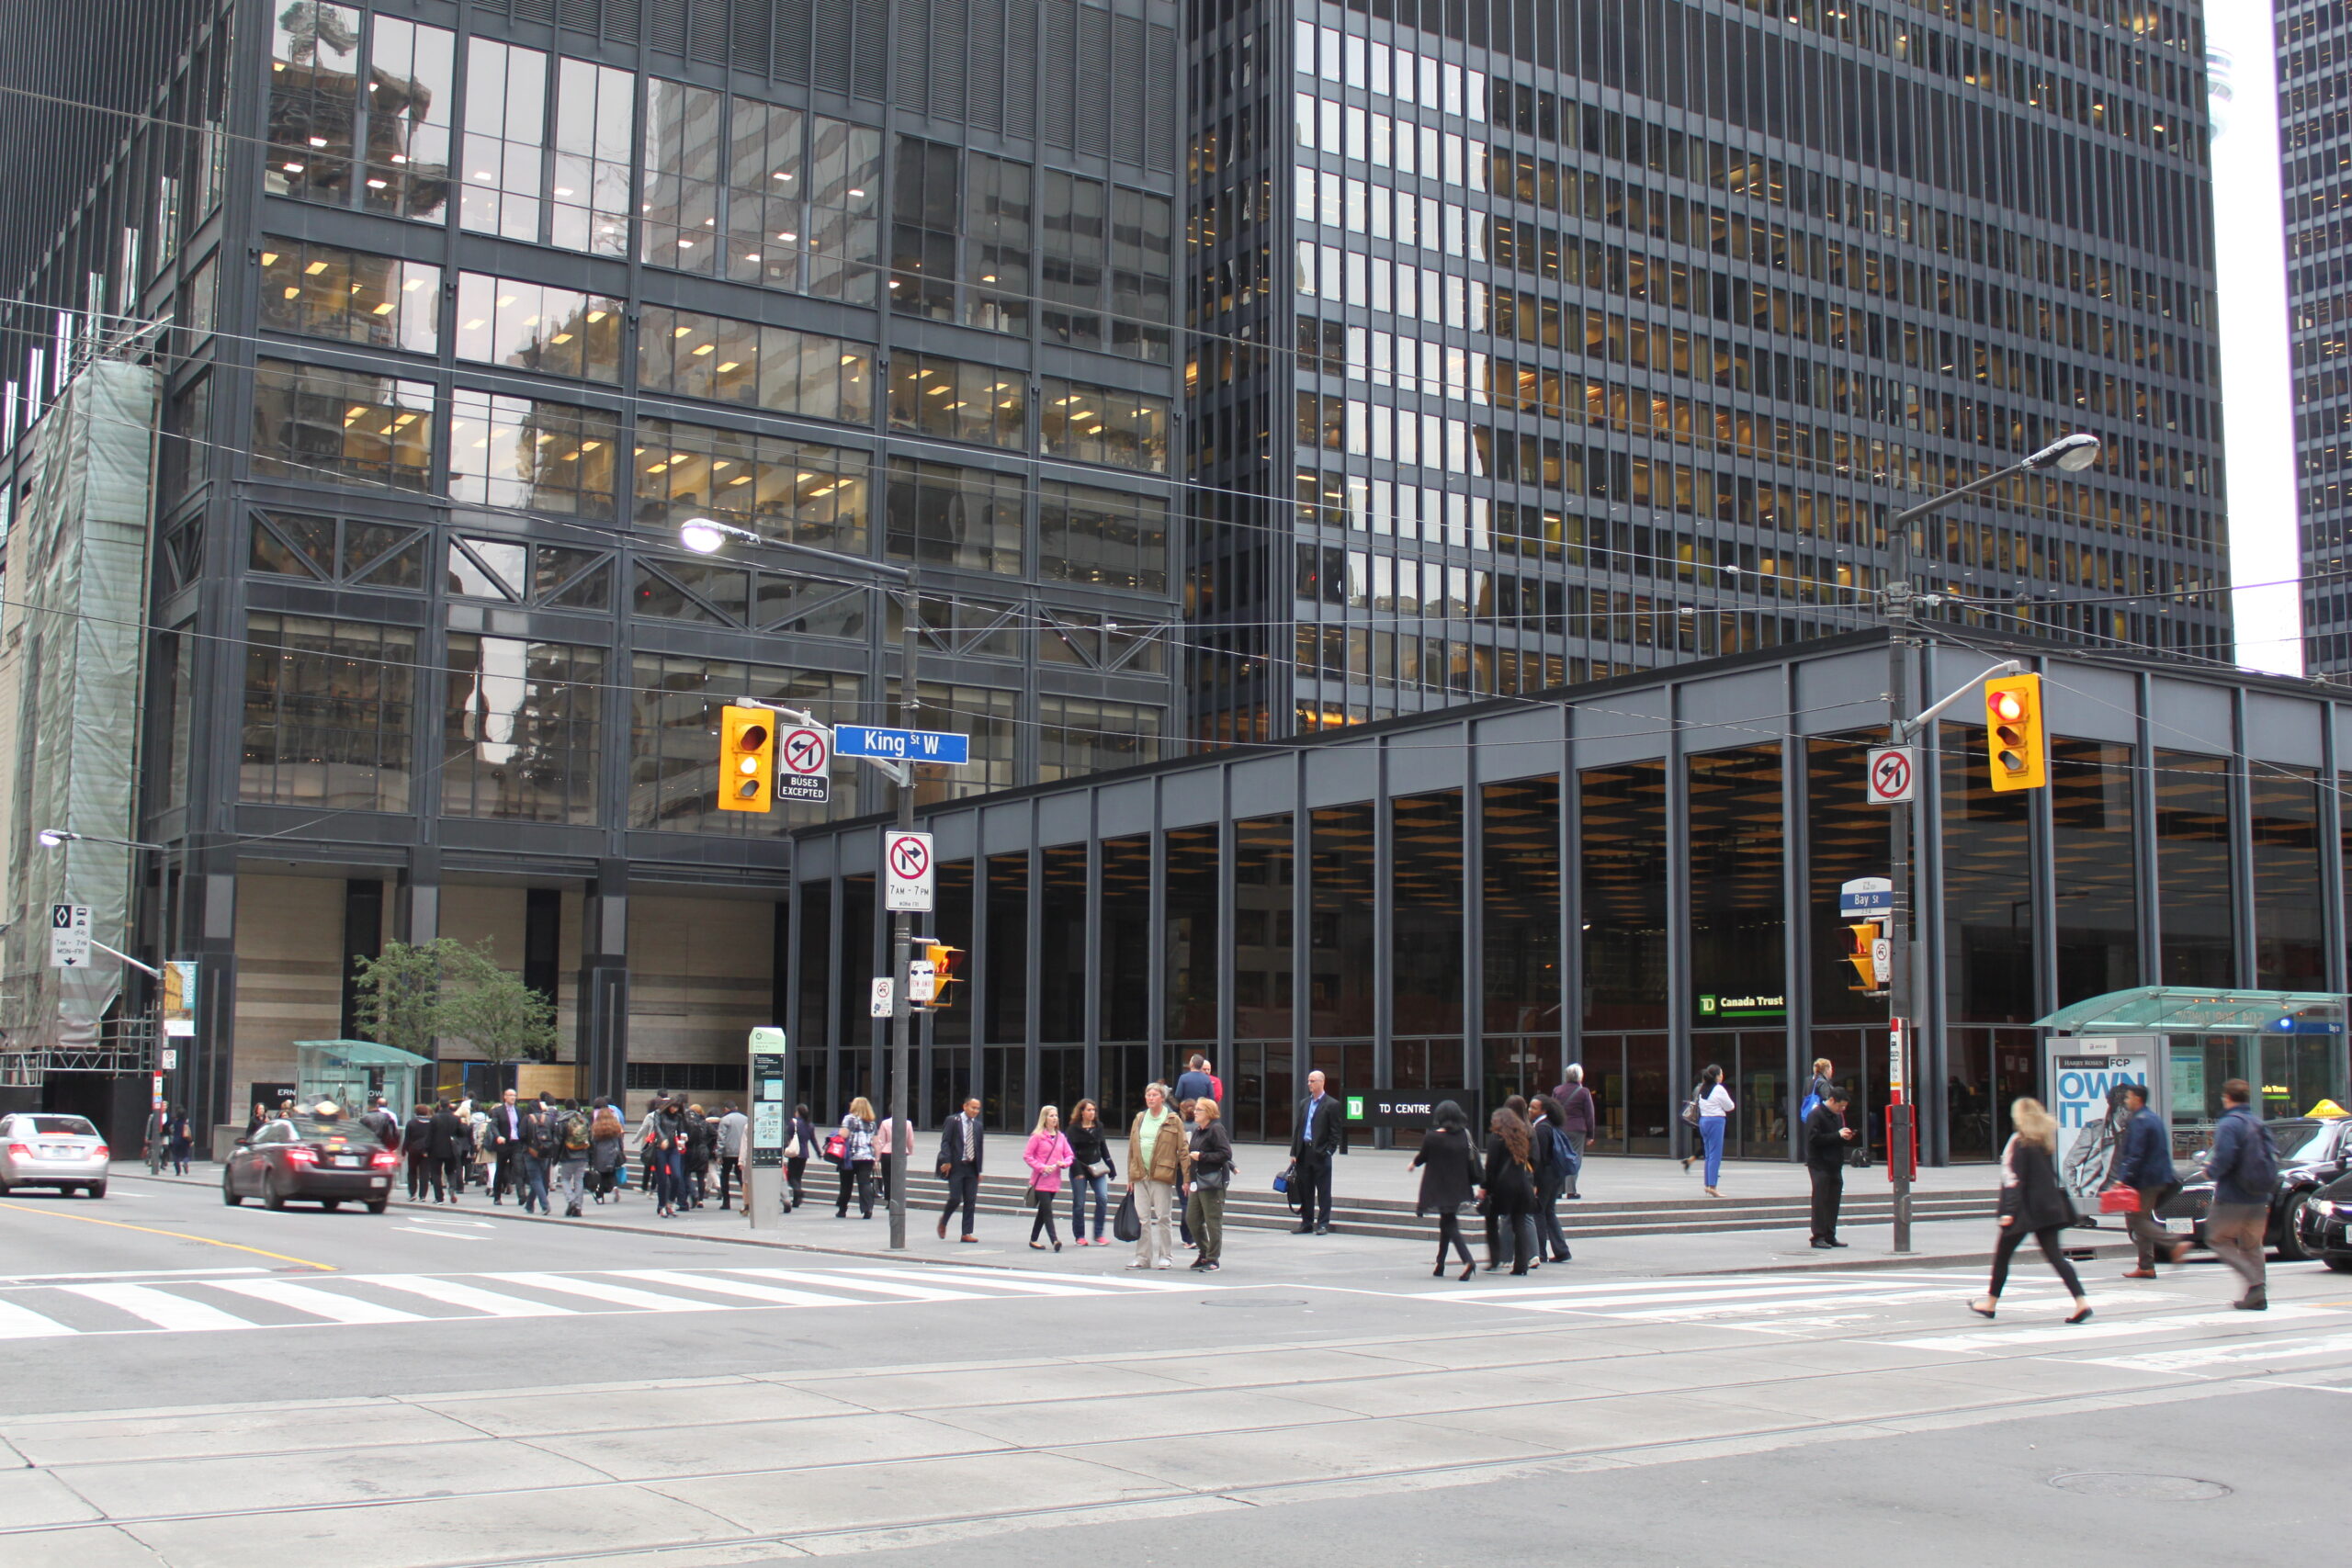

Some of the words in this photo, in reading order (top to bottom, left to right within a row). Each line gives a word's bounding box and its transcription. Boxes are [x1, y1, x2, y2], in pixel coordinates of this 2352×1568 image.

[865, 730, 905, 757] King
[910, 734, 920, 745] St
[923, 736, 939, 755] W
[790, 776, 819, 787] BUSES
[782, 786, 824, 798] EXCEPTED
[1854, 895, 1869, 906] Bay
[1872, 895, 1879, 903] St
[1700, 998, 1714, 1011] TD
[1720, 996, 1756, 1008] Canada
[1757, 995, 1783, 1006] Trust
[2109, 1058, 2131, 1066] FCP
[1349, 1100, 1363, 1115] TD
[1379, 1103, 1391, 1113] TD
[1396, 1104, 1430, 1113] CENTRE
[2059, 1101, 2089, 1128] IT
